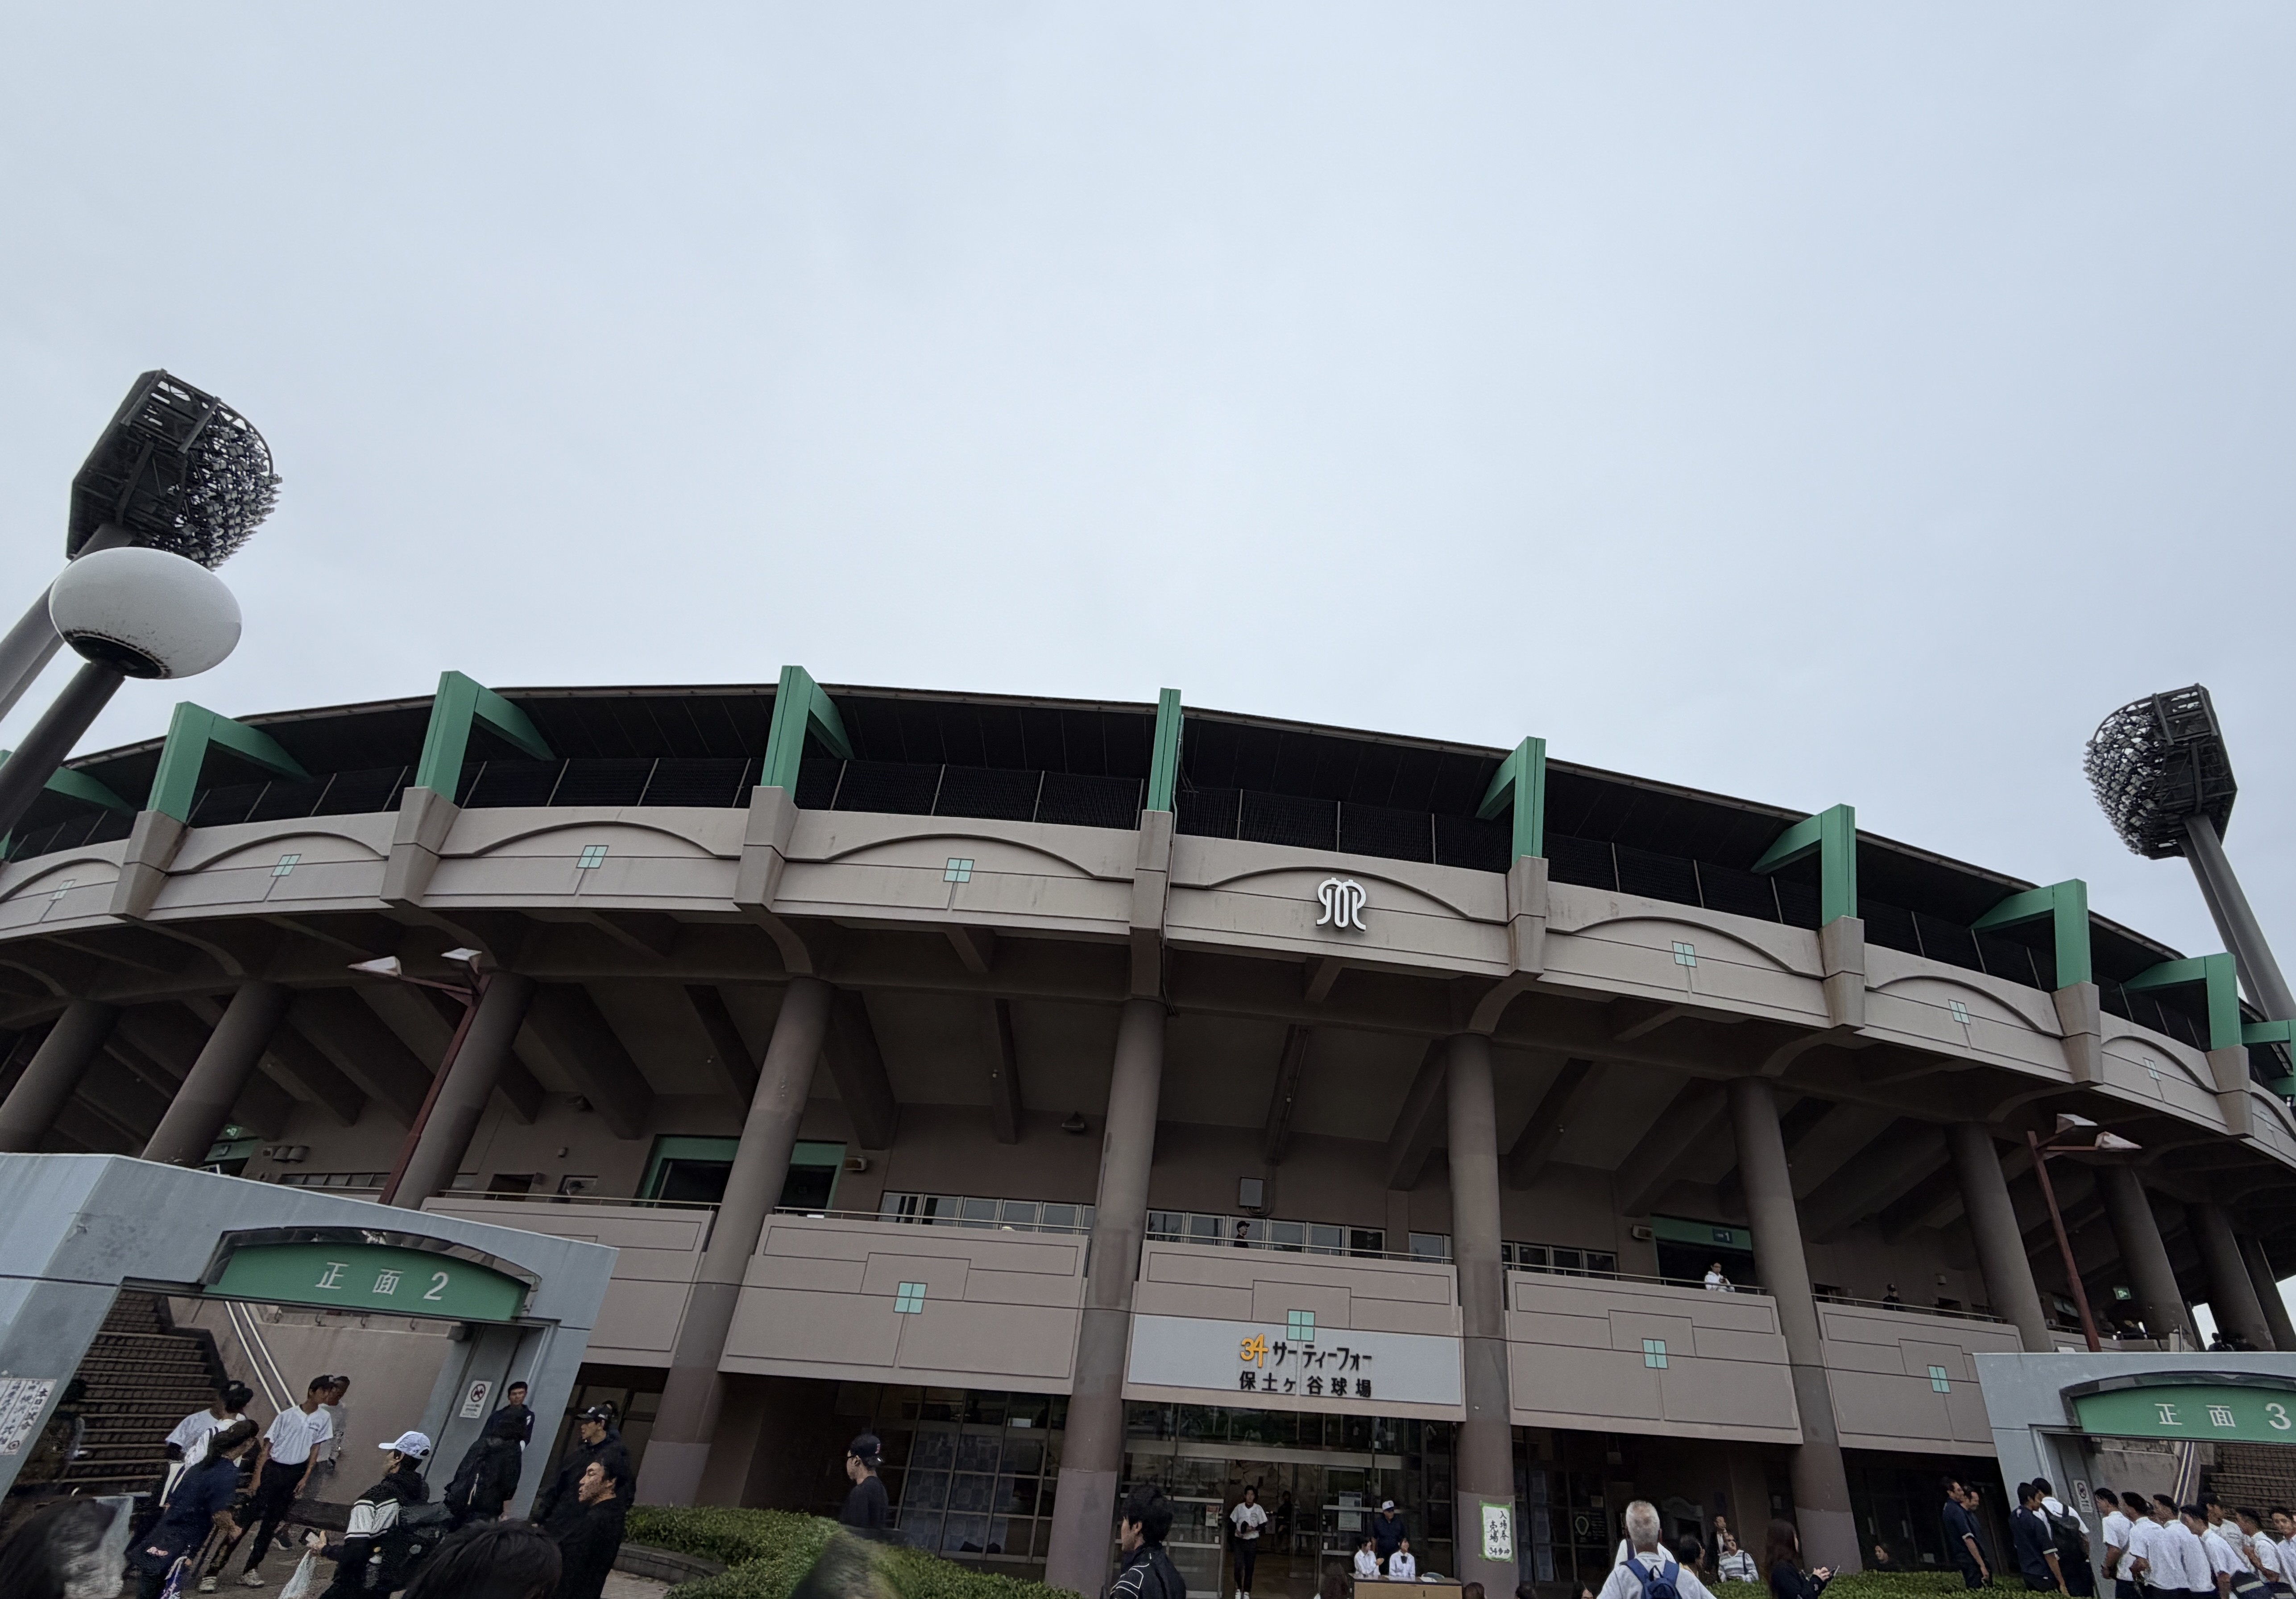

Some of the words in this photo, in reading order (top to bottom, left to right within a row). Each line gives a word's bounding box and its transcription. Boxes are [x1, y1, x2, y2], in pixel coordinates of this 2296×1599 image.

[1240, 1333, 1269, 1368] 34
[1272, 1341, 1372, 1371] サーティーフォー
[1239, 1370, 1372, 1398] 保土ヶ谷球場
